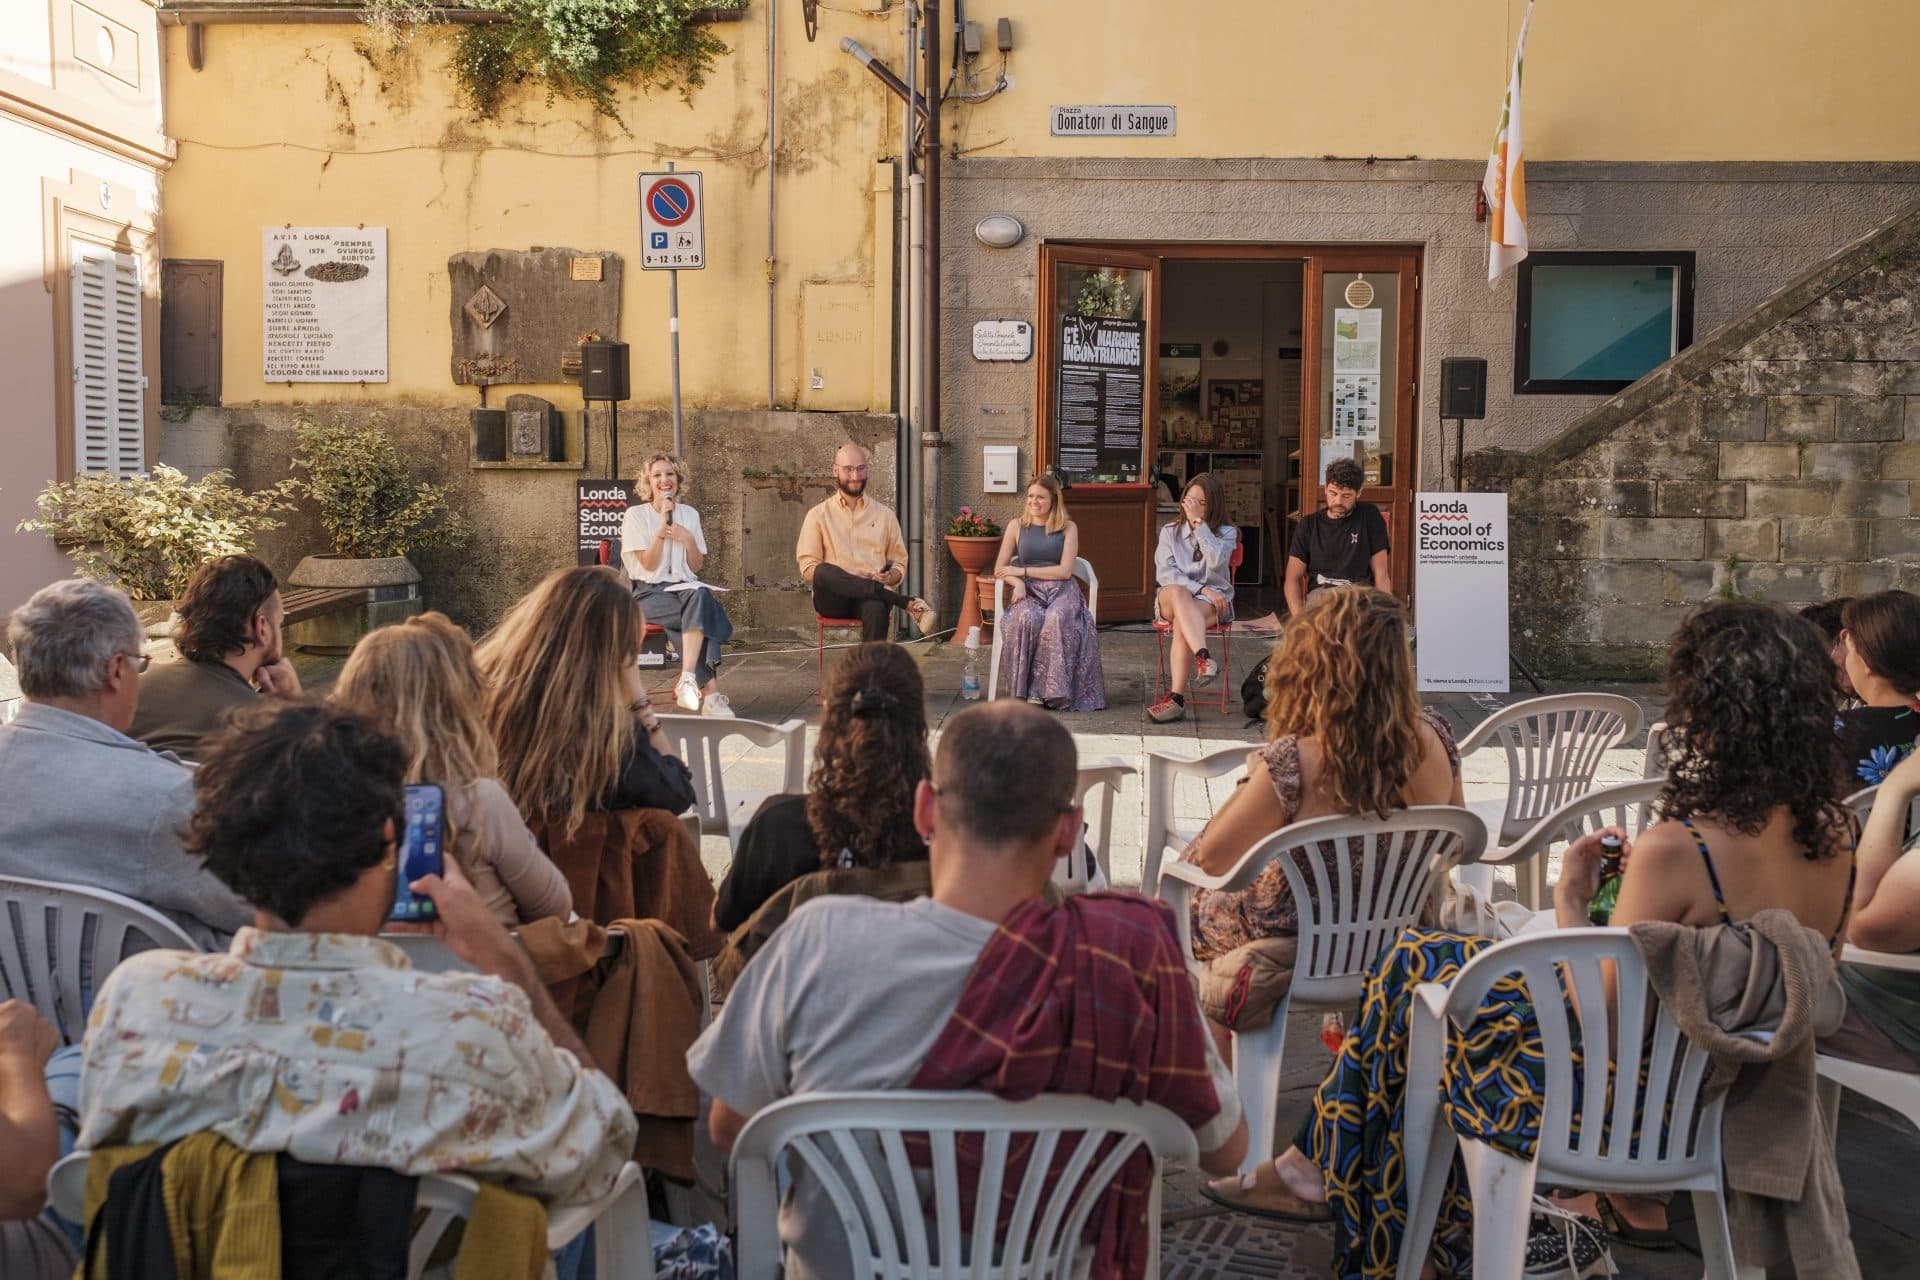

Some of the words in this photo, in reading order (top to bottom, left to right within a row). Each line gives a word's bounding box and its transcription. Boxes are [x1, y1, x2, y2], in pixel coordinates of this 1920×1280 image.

[1057, 113, 1105, 130] Donatori
[1112, 113, 1121, 130] di
[1128, 113, 1168, 133] Sangue
[655, 234, 664, 247] P
[646, 255, 651, 263] 9
[660, 255, 668, 263] 12
[673, 254, 682, 263] 15
[690, 254, 699, 262] 19
[1063, 324, 1079, 345] C'È
[1097, 329, 1140, 350] MARGINE
[1063, 343, 1140, 366] INCONTRIAMOCI
[580, 486, 627, 500] Londa
[1420, 500, 1468, 513] Londa
[580, 508, 624, 522] Schoo
[580, 522, 624, 536] Econo
[1420, 522, 1472, 536] School
[1475, 522, 1492, 536] of
[1420, 536, 1504, 551] Economics
